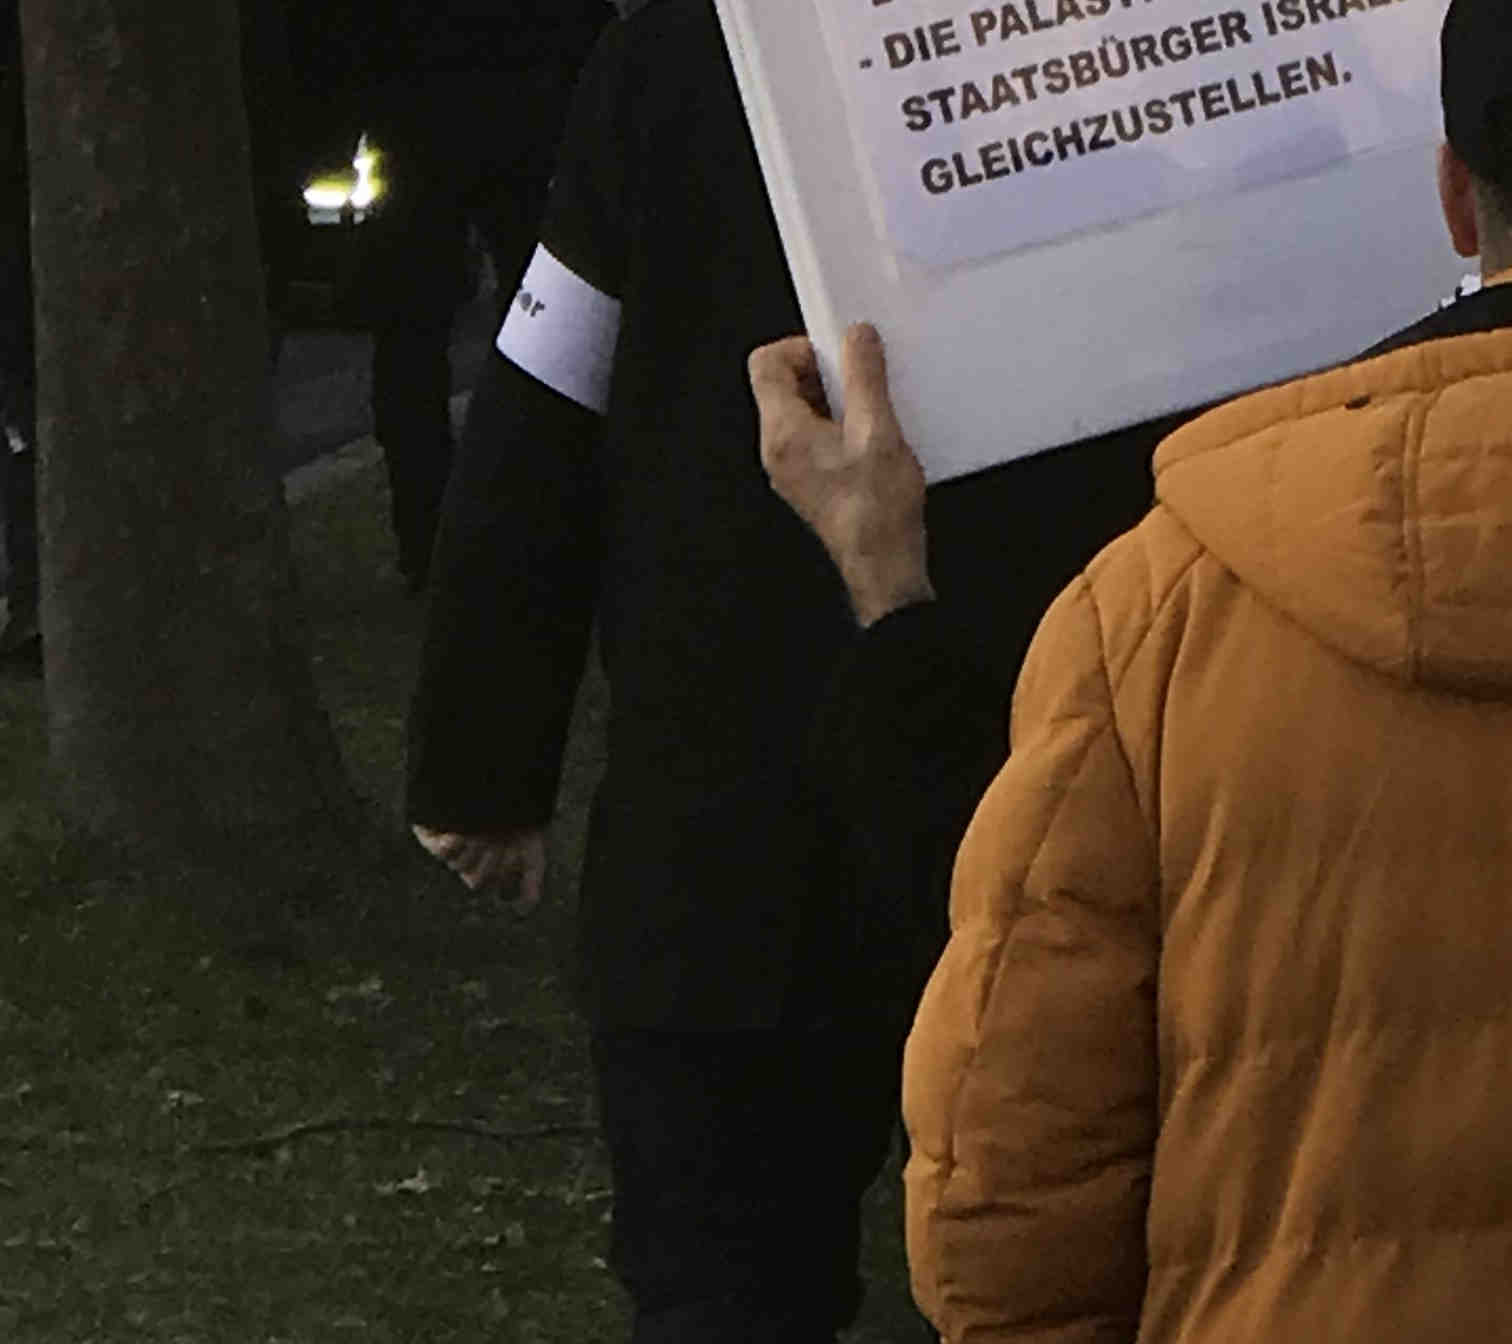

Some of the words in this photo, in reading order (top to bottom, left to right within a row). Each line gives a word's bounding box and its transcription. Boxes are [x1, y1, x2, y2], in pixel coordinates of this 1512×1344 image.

[884, 23, 961, 70] DIE
[900, 11, 1252, 132] STAATSBÜRGER
[920, 53, 1353, 196] GLEICHZUSTELLEN.
